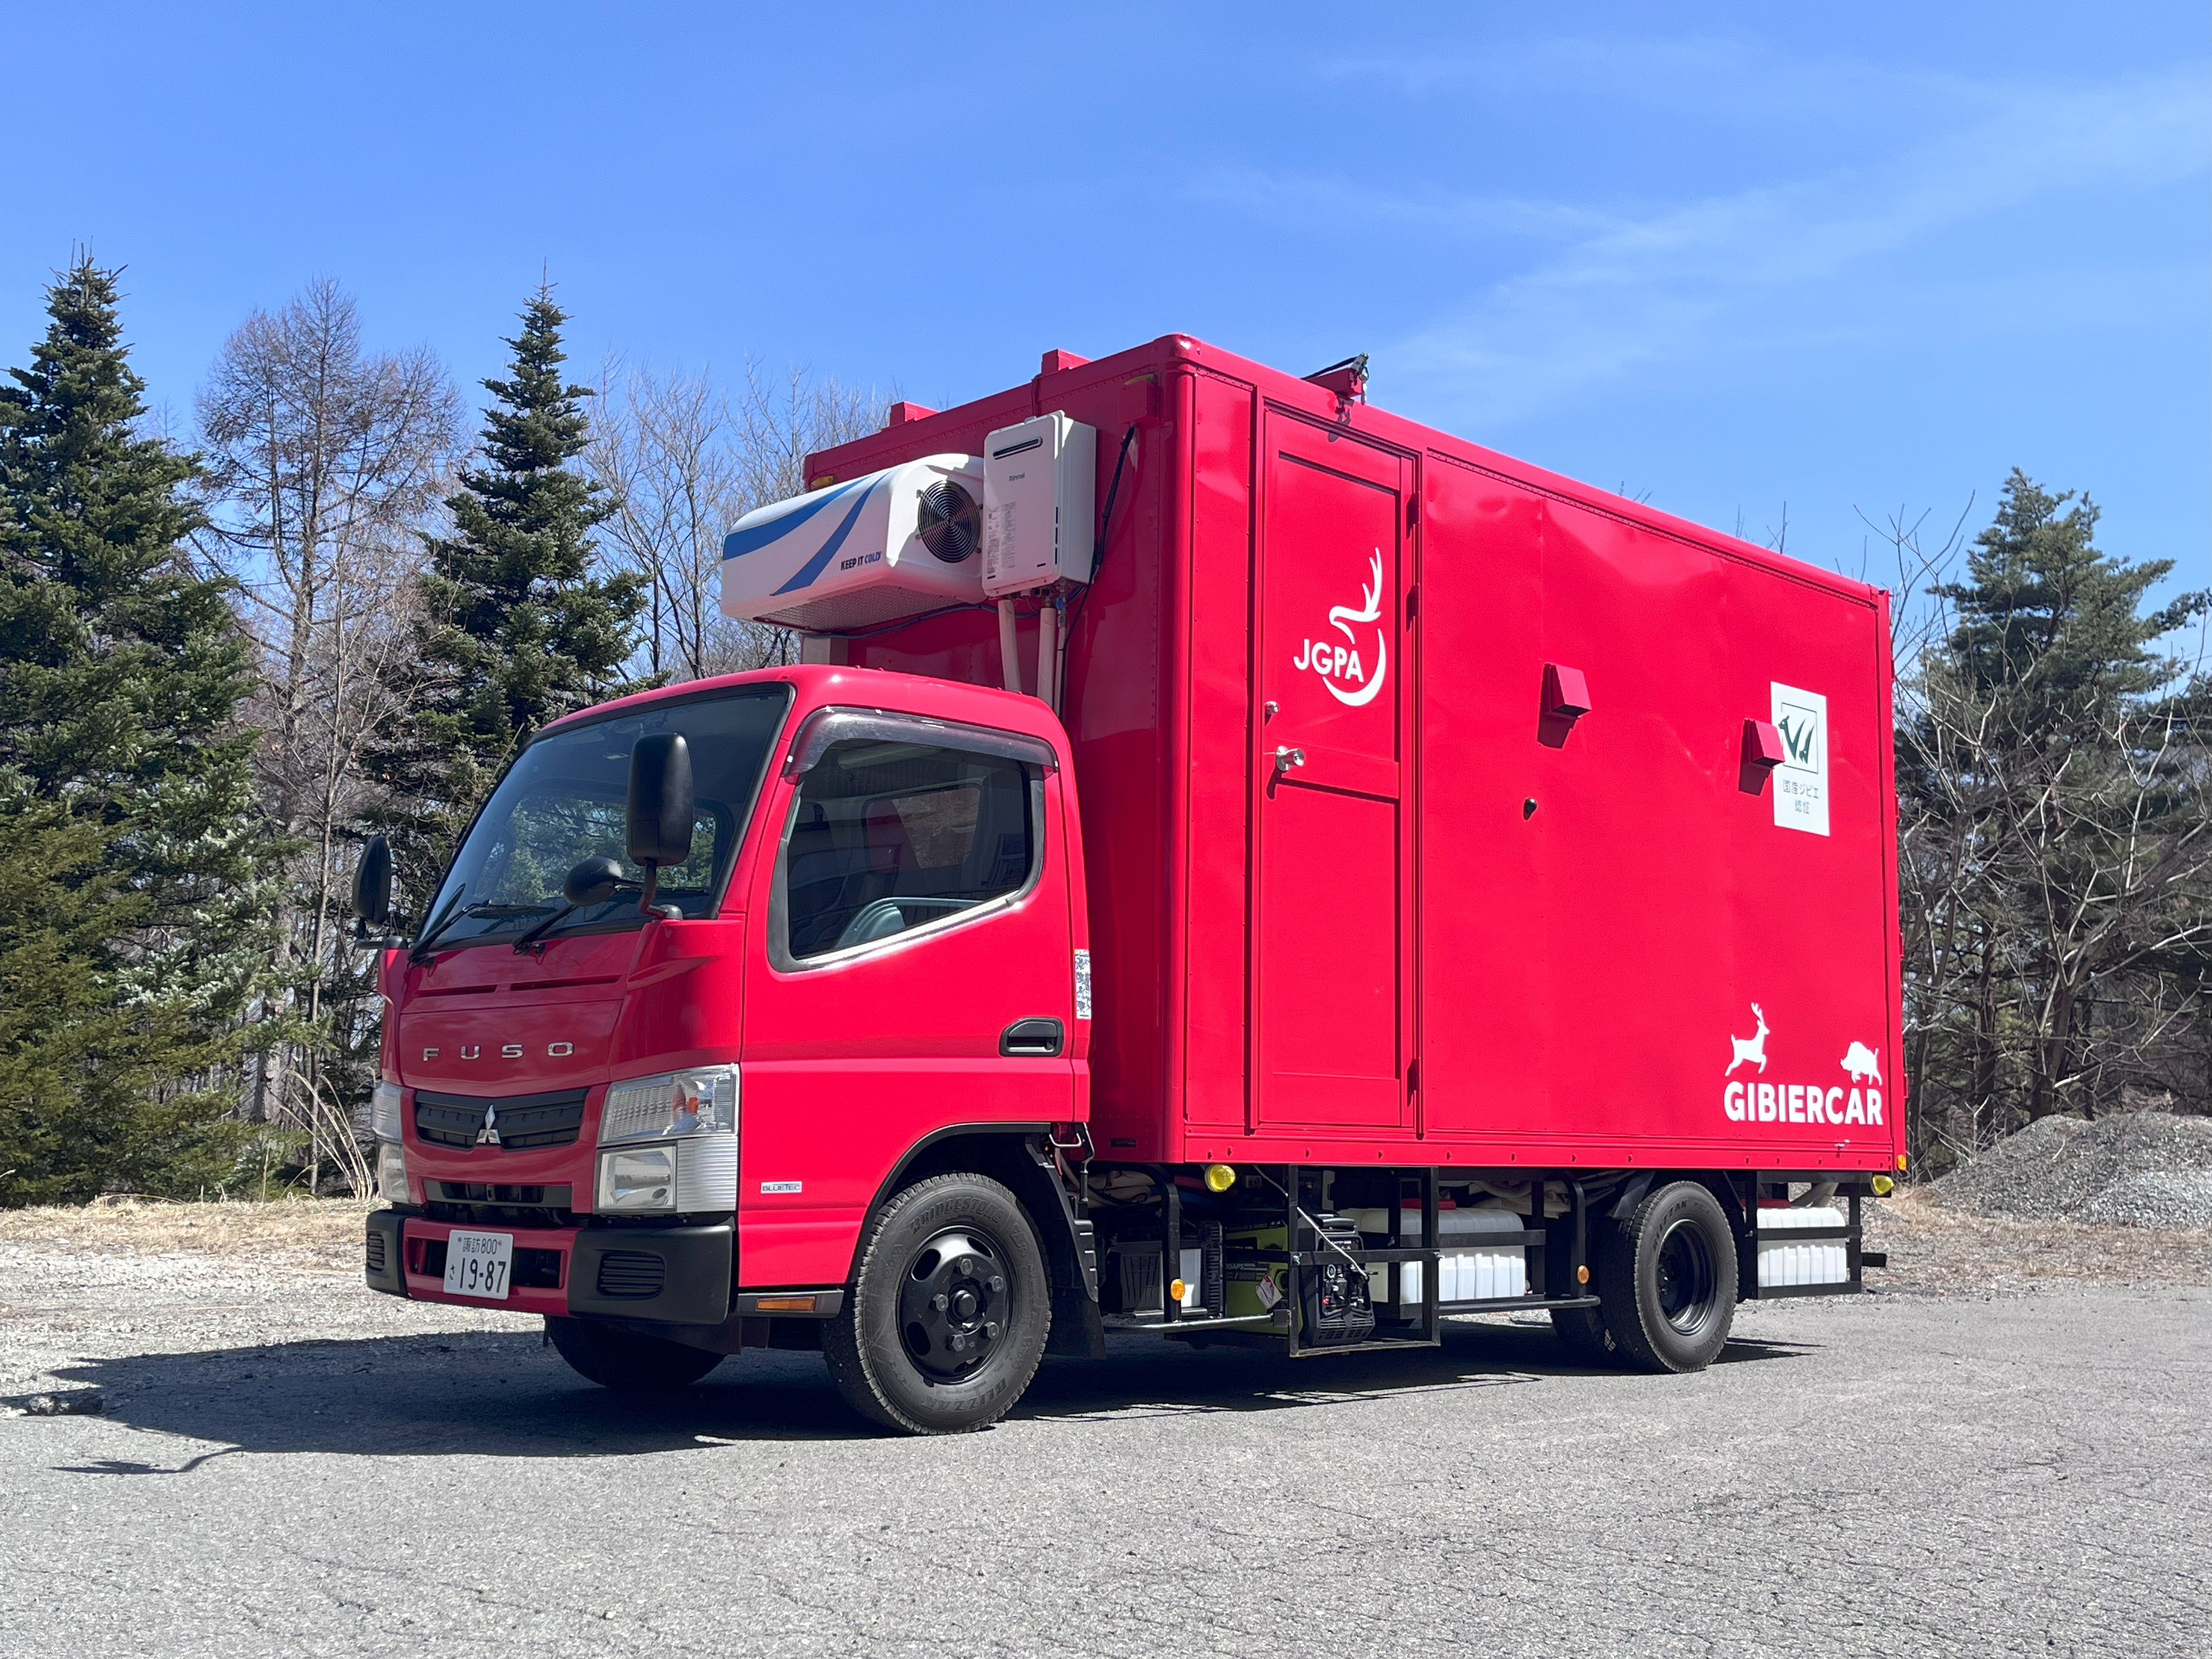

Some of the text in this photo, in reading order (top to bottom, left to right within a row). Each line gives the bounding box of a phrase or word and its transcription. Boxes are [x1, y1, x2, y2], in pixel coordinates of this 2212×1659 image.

[840, 551, 882, 571] KEEP IT COLD
[1293, 639, 1364, 682] JGPA
[423, 1041, 574, 1061] FUSO
[1724, 1081, 1883, 1125] GIBIERCAR
[911, 1197, 1005, 1234] BRIDGESTONE
[460, 1257, 506, 1293] 19-87
